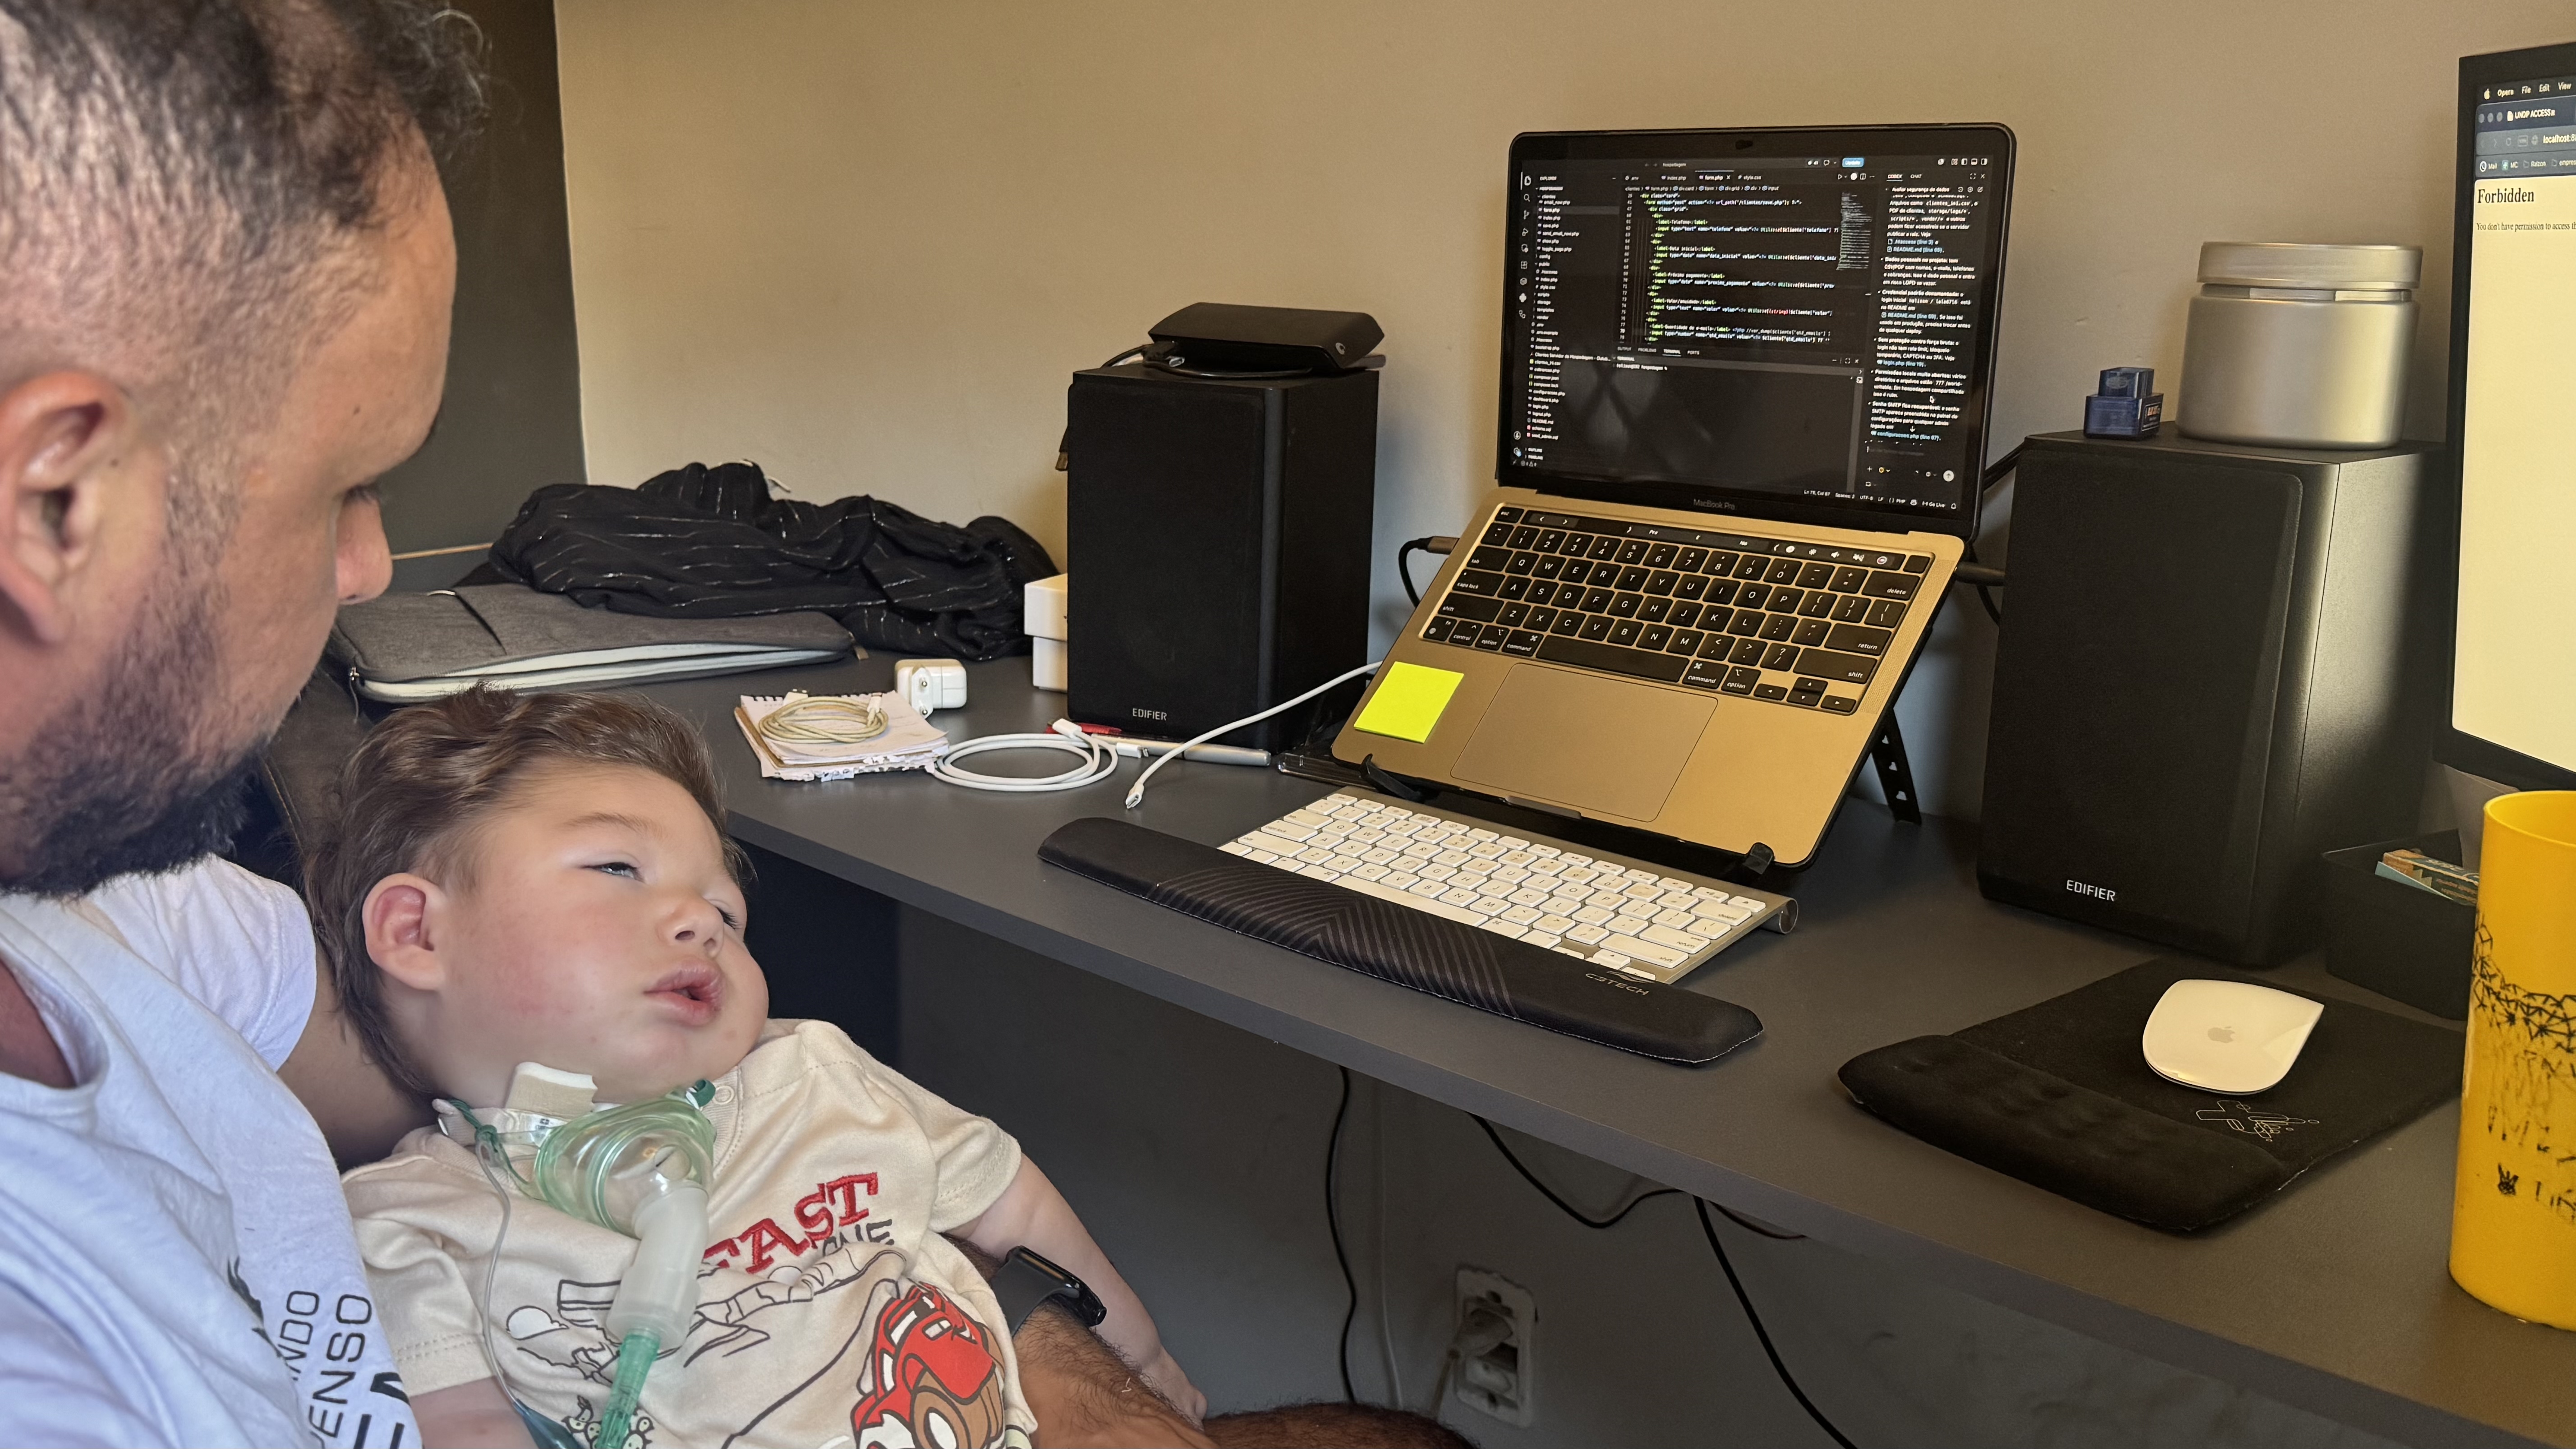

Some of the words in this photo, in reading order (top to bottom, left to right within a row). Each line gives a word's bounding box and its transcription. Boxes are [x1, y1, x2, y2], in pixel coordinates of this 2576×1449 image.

[2497, 89, 2514, 97] Opera
[2521, 86, 2531, 94] File
[2539, 84, 2550, 92] Edit
[2558, 82, 2571, 90] View
[2477, 188, 2534, 203] Forbidden
[2515, 222, 2544, 232] permission
[1693, 498, 1723, 509] MacBook
[1680, 637, 1689, 645] M
[1688, 675, 1716, 684] command
[1132, 708, 1167, 721] EDIFIER
[2066, 879, 2116, 902] EDIFIER
[1585, 973, 1649, 995] C3TECH
[704, 1172, 878, 1274] FAST
[277, 1290, 319, 1381] NDO
